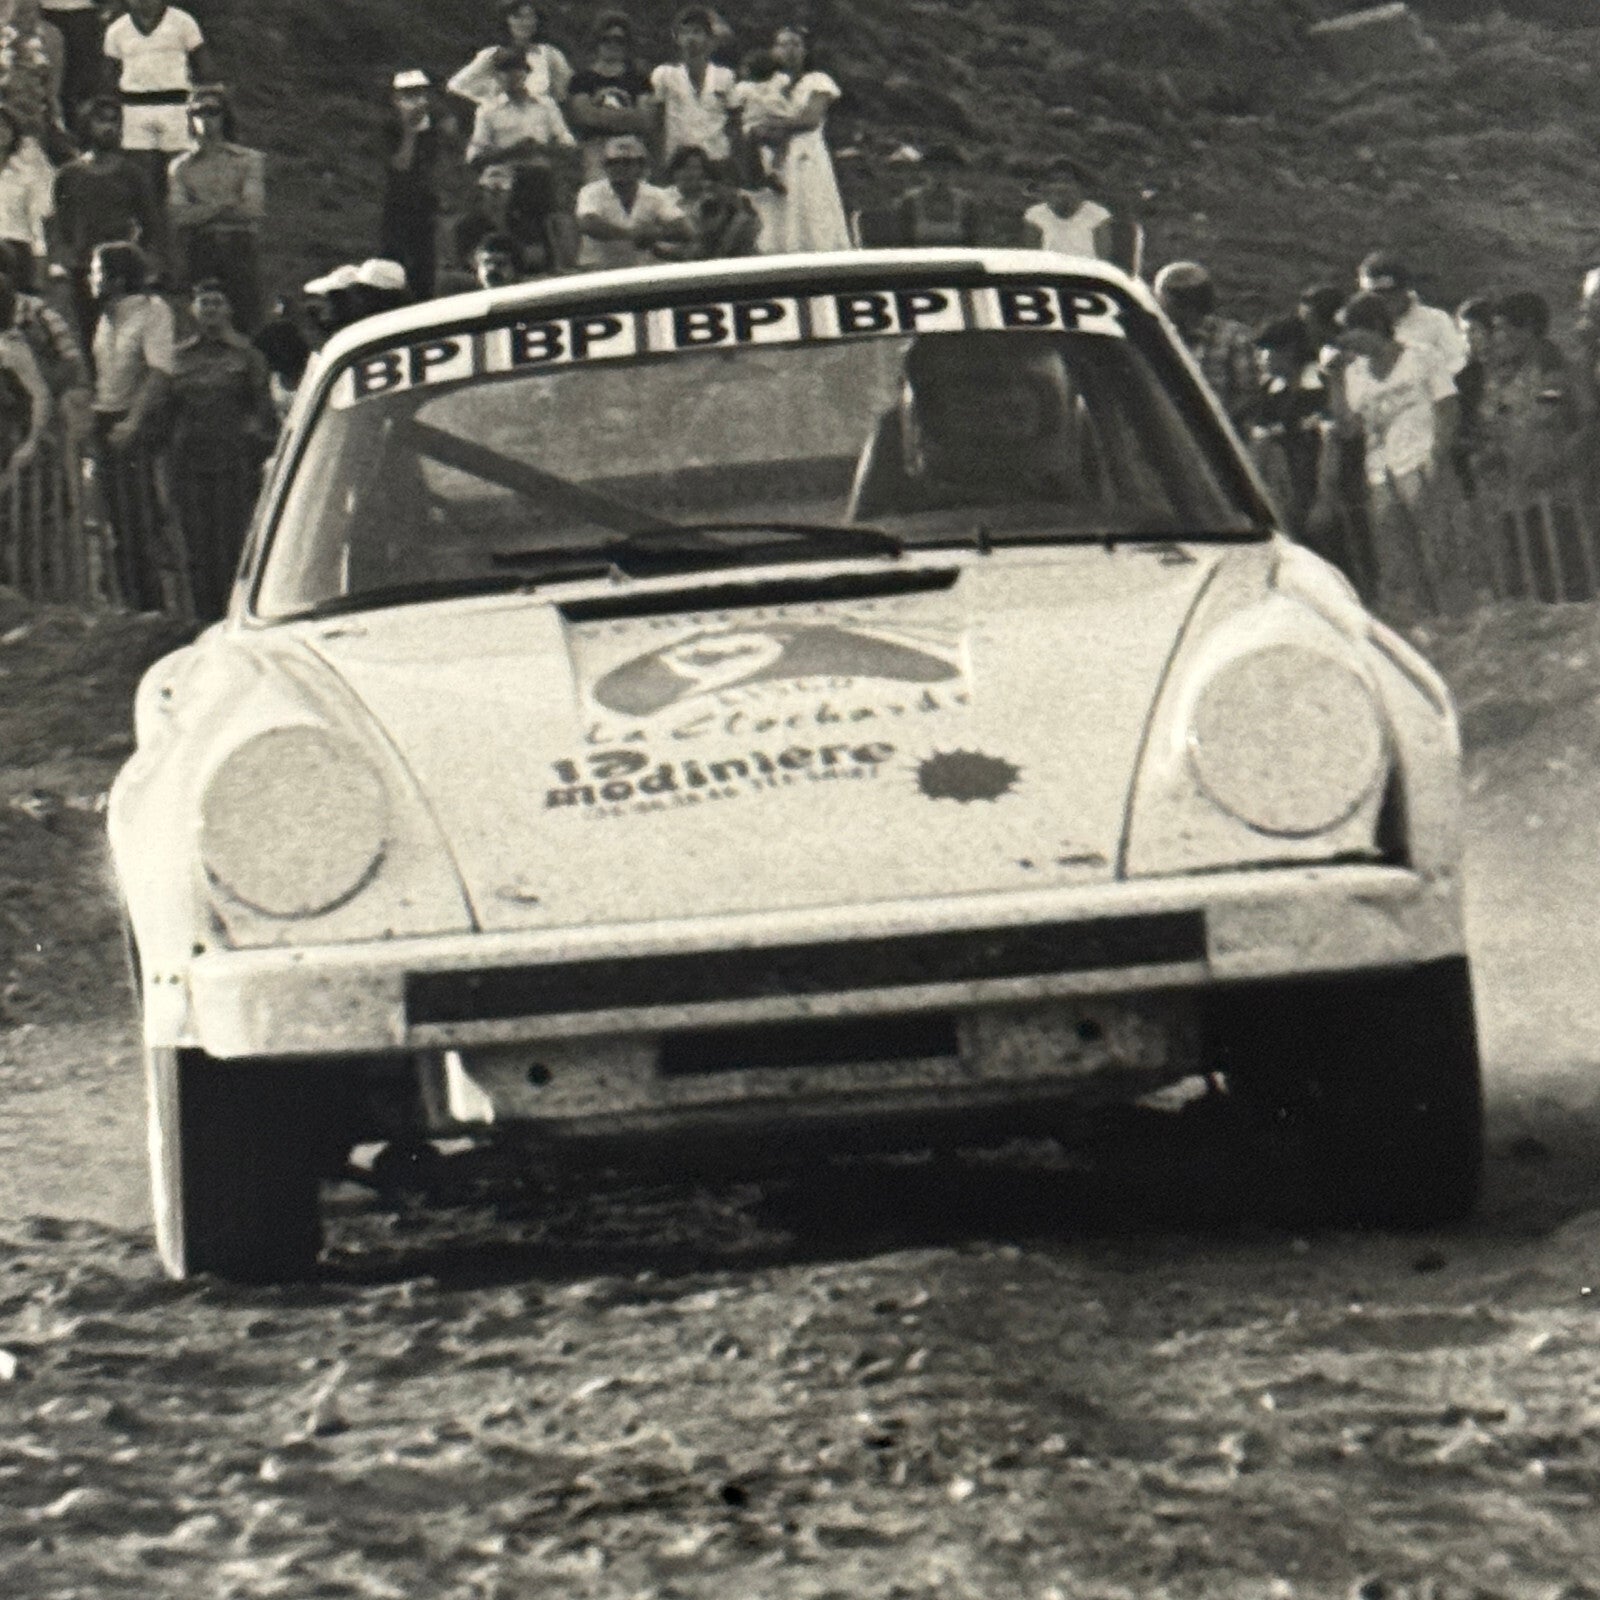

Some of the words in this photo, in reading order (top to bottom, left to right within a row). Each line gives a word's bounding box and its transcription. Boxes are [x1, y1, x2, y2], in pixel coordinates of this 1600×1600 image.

[354, 337, 461, 398] BP
[511, 315, 623, 365] BP
[674, 301, 786, 347] BP
[835, 290, 949, 334] BP
[997, 287, 1108, 330] BP
